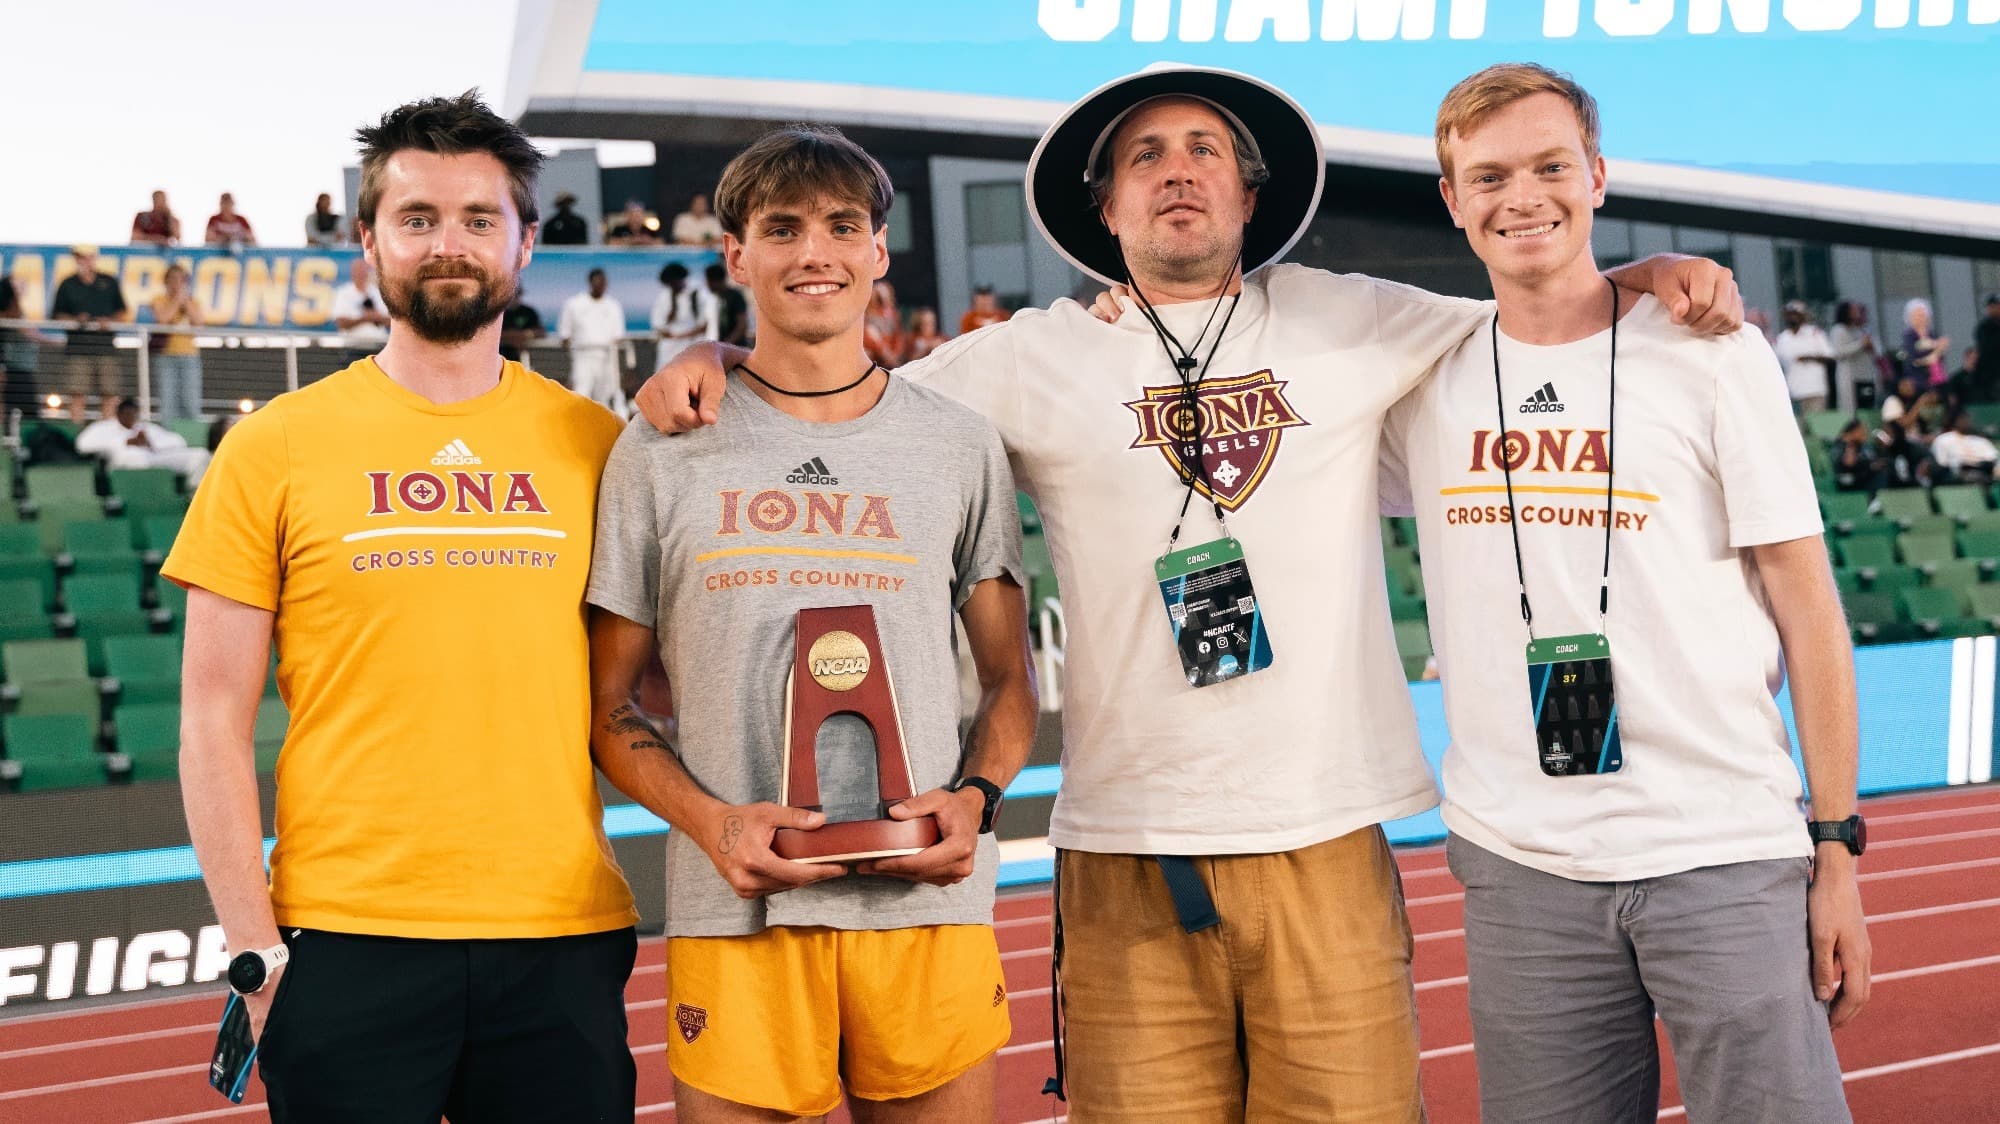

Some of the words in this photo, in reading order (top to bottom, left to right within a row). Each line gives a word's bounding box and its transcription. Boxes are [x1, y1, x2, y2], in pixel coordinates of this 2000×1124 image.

[1124, 382, 1309, 447] IONA
[1519, 401, 1565, 414] adidas
[1184, 434, 1260, 457] GAELS
[1468, 428, 1616, 475] IONA
[431, 455, 482, 465] adidas
[786, 472, 839, 486] adidas
[363, 471, 551, 516] IONA
[714, 488, 902, 541] IONA
[1446, 505, 1513, 525] CROSS
[1520, 505, 1649, 531] COUNTRY
[351, 549, 435, 572] CROSS
[446, 549, 558, 568] COUNTRY
[1186, 552, 1210, 565] COACH
[705, 568, 779, 593] CROSS
[789, 568, 906, 593] COUNTRY
[1203, 622, 1235, 638] #NCAATF
[1556, 643, 1578, 653] COACH
[814, 657, 868, 676] NCAA
[1563, 674, 1577, 683] 37
